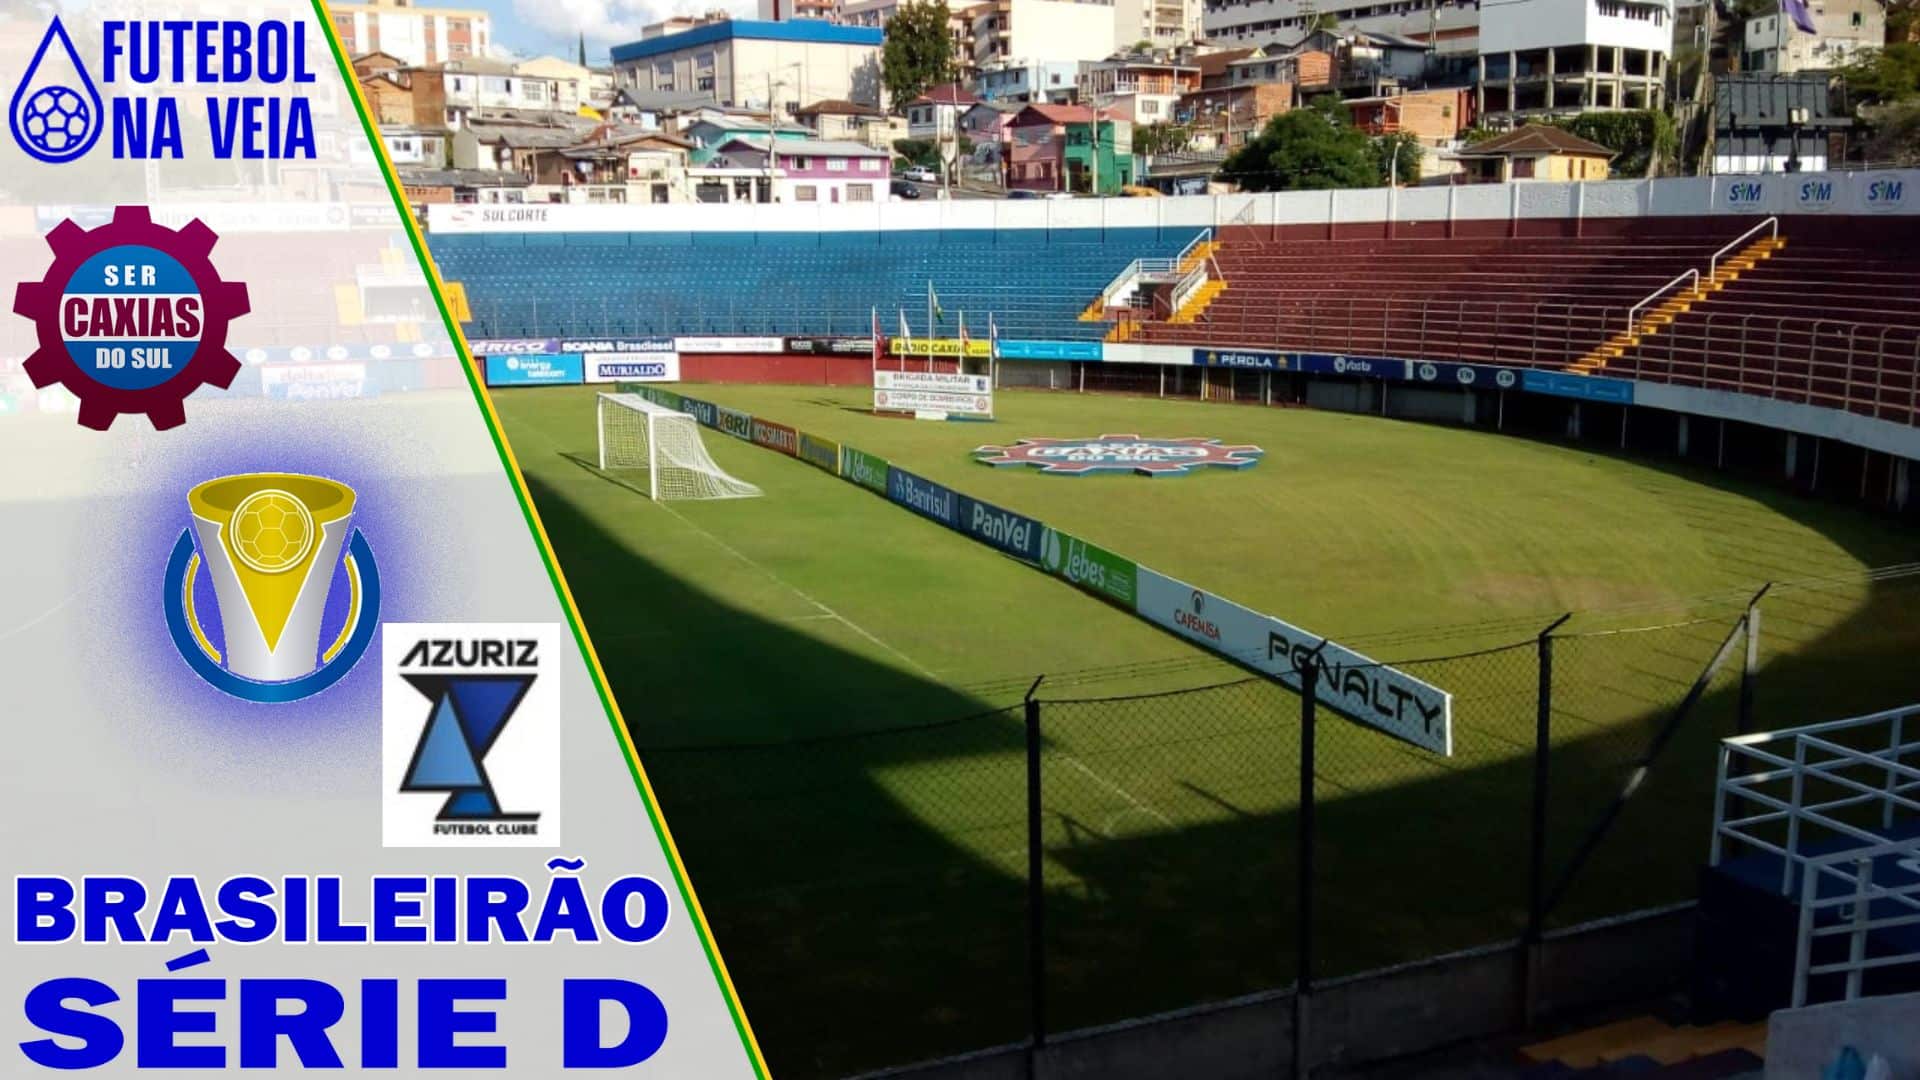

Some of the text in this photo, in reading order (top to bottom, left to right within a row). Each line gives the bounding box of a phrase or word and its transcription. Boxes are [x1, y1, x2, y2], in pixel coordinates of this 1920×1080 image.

[482, 208, 548, 222] SULCORTE
[562, 341, 615, 352] SCANIA
[1222, 353, 1272, 367] PÉROLA
[600, 364, 664, 376] MURIALDO
[905, 478, 950, 520] Banrisul
[972, 503, 1030, 551] PanVel
[1269, 631, 1440, 734] PENALTY
